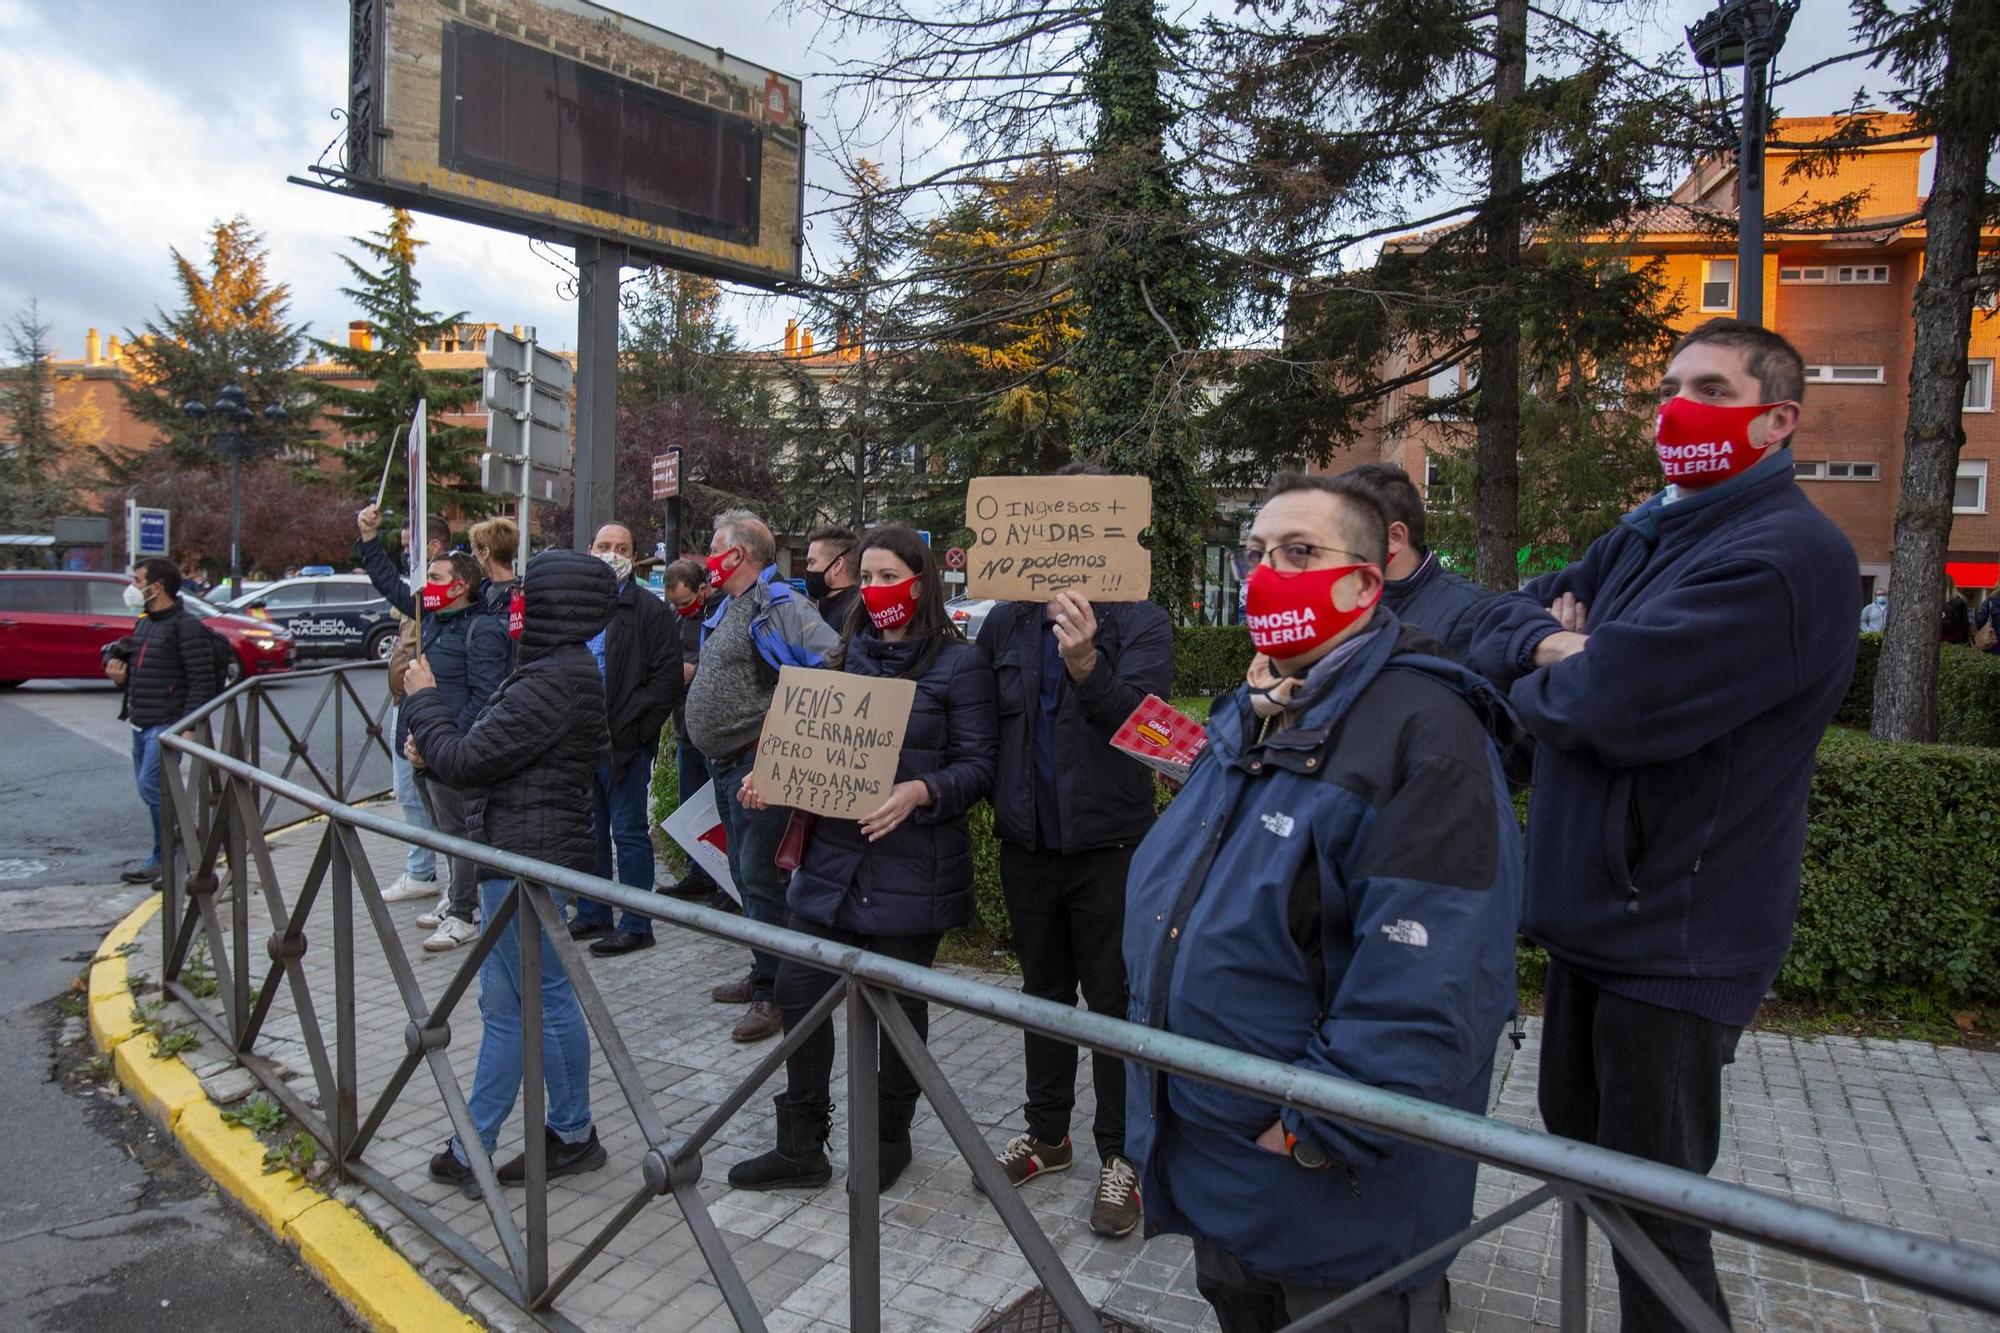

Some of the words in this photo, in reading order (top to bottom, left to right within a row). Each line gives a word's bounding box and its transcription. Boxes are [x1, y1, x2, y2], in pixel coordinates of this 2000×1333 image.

[1017, 552, 1107, 578] podemos
[288, 618, 346, 628] POLICÍA
[288, 627, 363, 636] NACIONAL
[854, 691, 872, 720] A
[772, 762, 780, 781] A
[789, 765, 881, 795] AYUDARNOS
